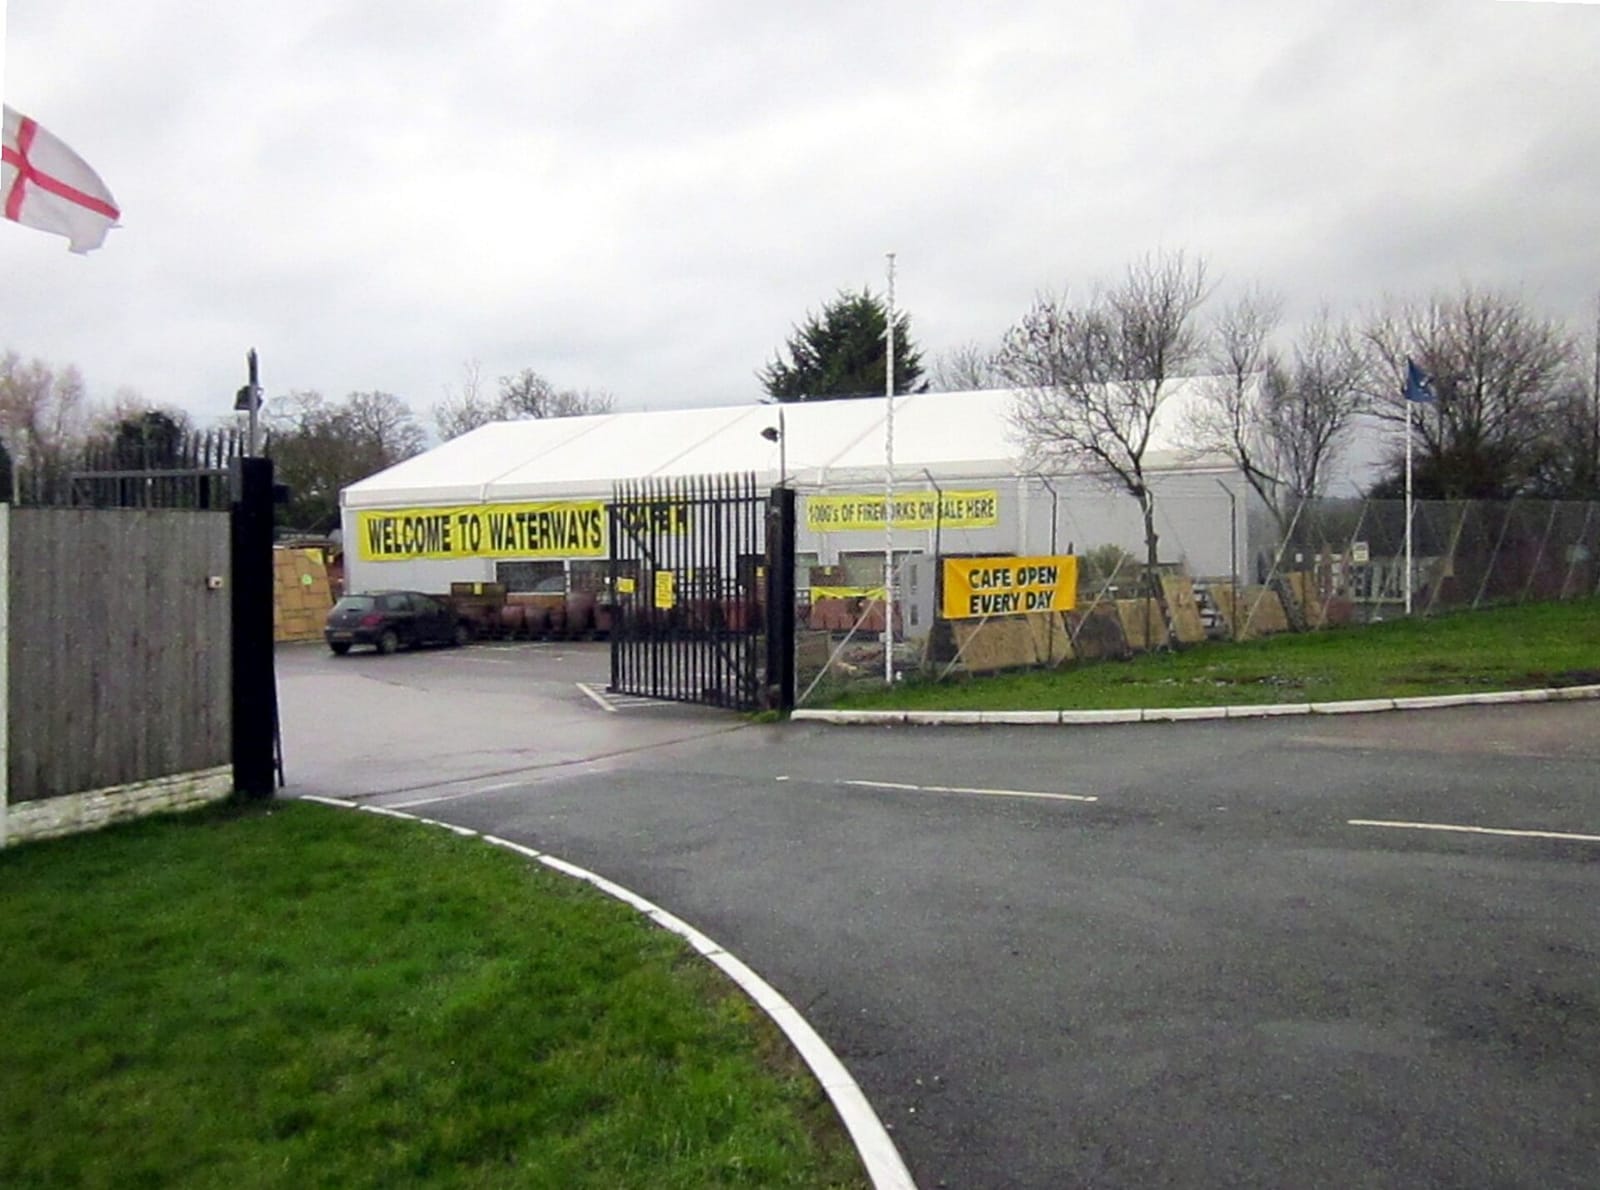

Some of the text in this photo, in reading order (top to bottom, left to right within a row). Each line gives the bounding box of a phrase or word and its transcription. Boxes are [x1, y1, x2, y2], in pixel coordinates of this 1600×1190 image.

[841, 503, 855, 522] OF
[919, 501, 935, 519] ON
[966, 498, 995, 518] HERE
[367, 514, 451, 554] WELCOME
[458, 513, 481, 552] TO
[488, 509, 601, 551] WATERWAYS
[969, 566, 1058, 589] CAFE OPEN
[970, 591, 1054, 614] EVERY DAY
